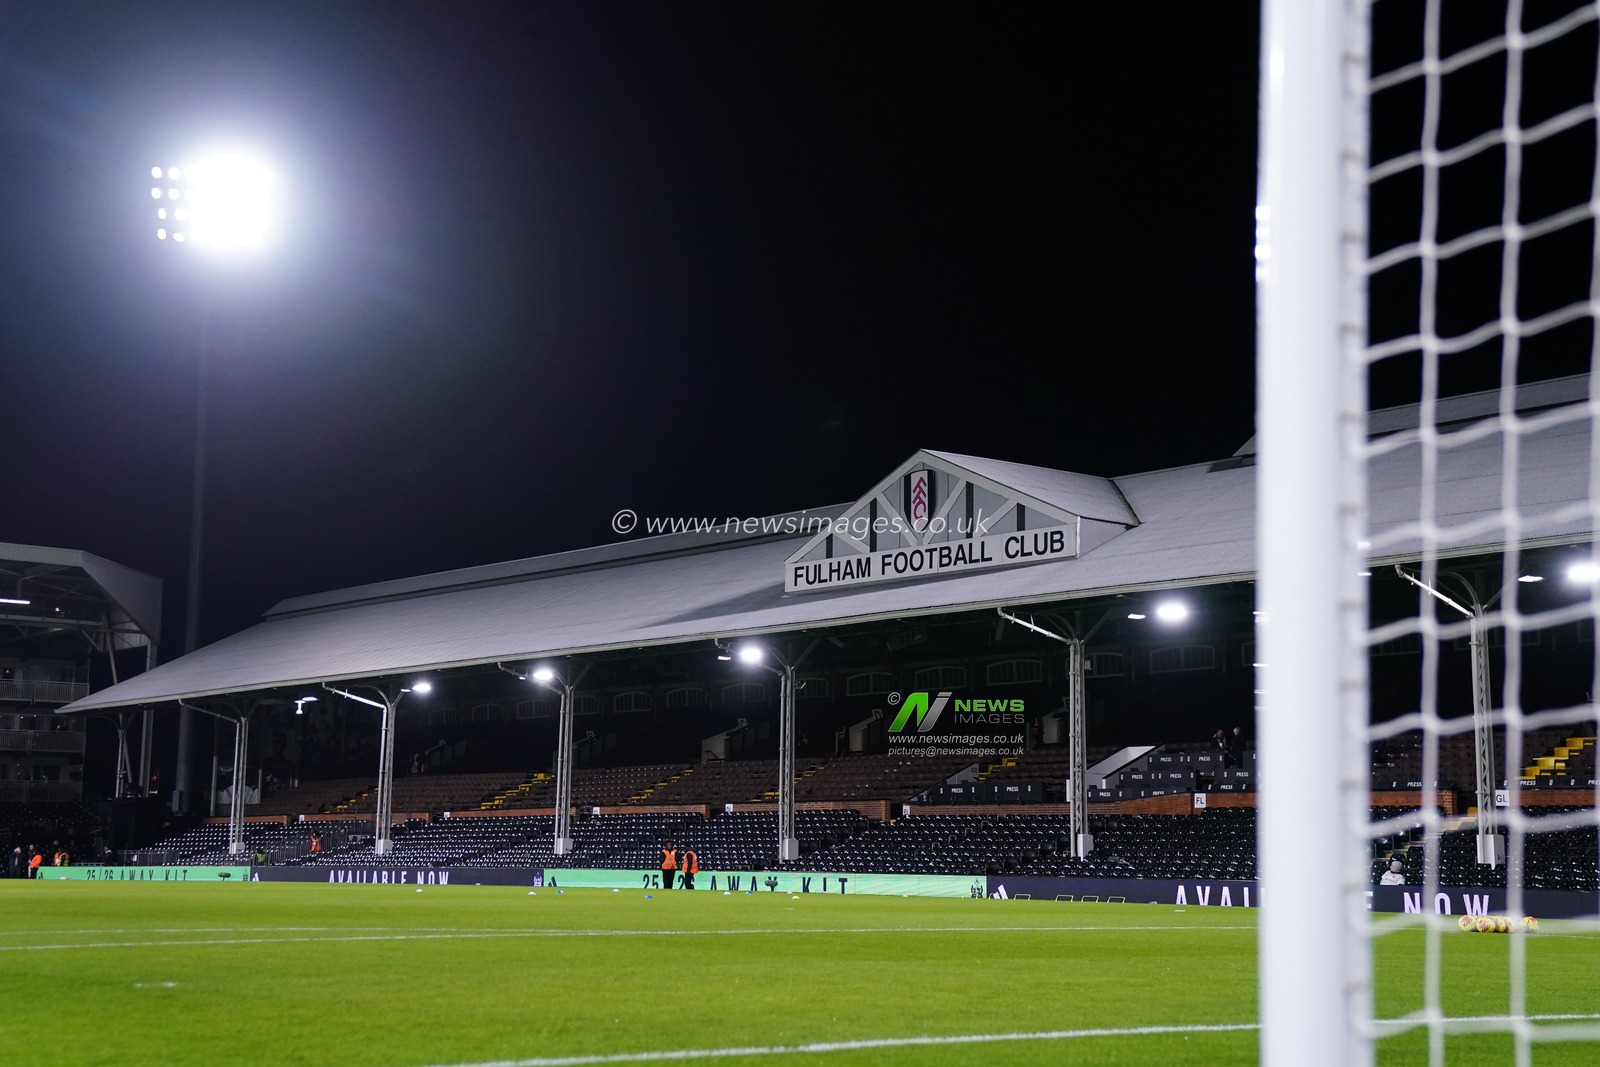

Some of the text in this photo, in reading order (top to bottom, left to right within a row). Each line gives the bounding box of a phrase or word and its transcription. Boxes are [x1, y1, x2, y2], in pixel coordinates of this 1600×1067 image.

[793, 529, 1065, 587] FULHAM FOOTBALL CLUB
[1195, 796, 1205, 805] FL
[1495, 794, 1509, 803] GL
[86, 869, 188, 881] 25/26 AWAY KIT
[416, 870, 450, 885] NOW
[710, 875, 778, 892] AWAY
[802, 877, 848, 894] KIT
[1403, 892, 1490, 916] NOW
